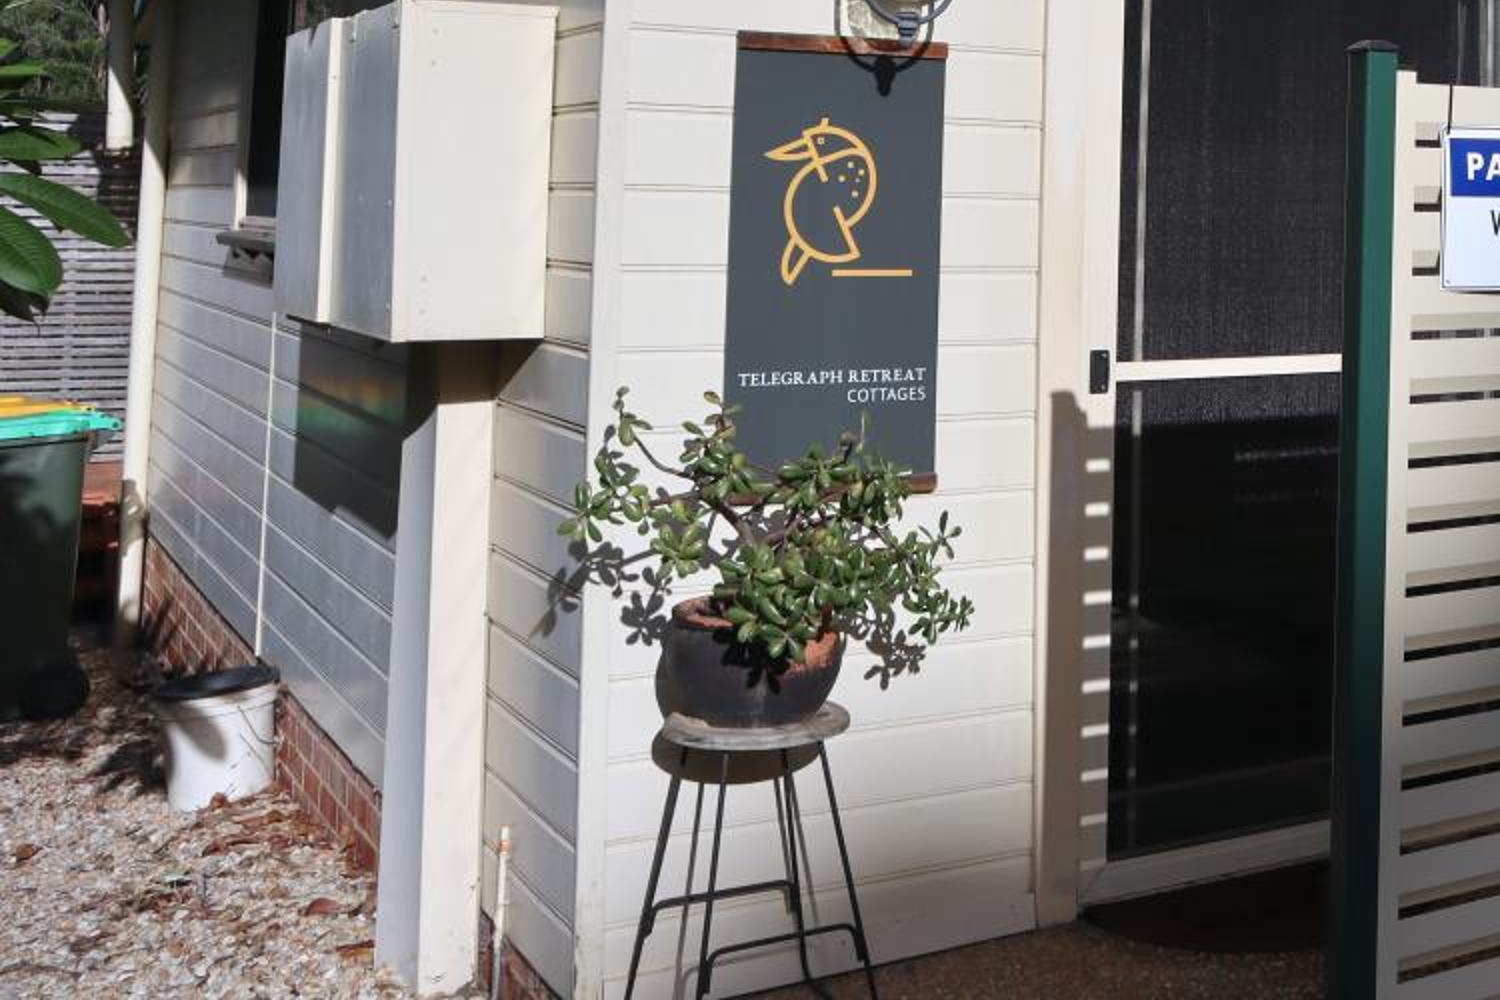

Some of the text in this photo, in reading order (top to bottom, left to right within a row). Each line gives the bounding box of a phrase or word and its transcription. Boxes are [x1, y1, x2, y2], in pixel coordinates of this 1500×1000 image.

[738, 367, 927, 387] TELEGRAPH RETREAT
[847, 386, 927, 403] COTTAGES
